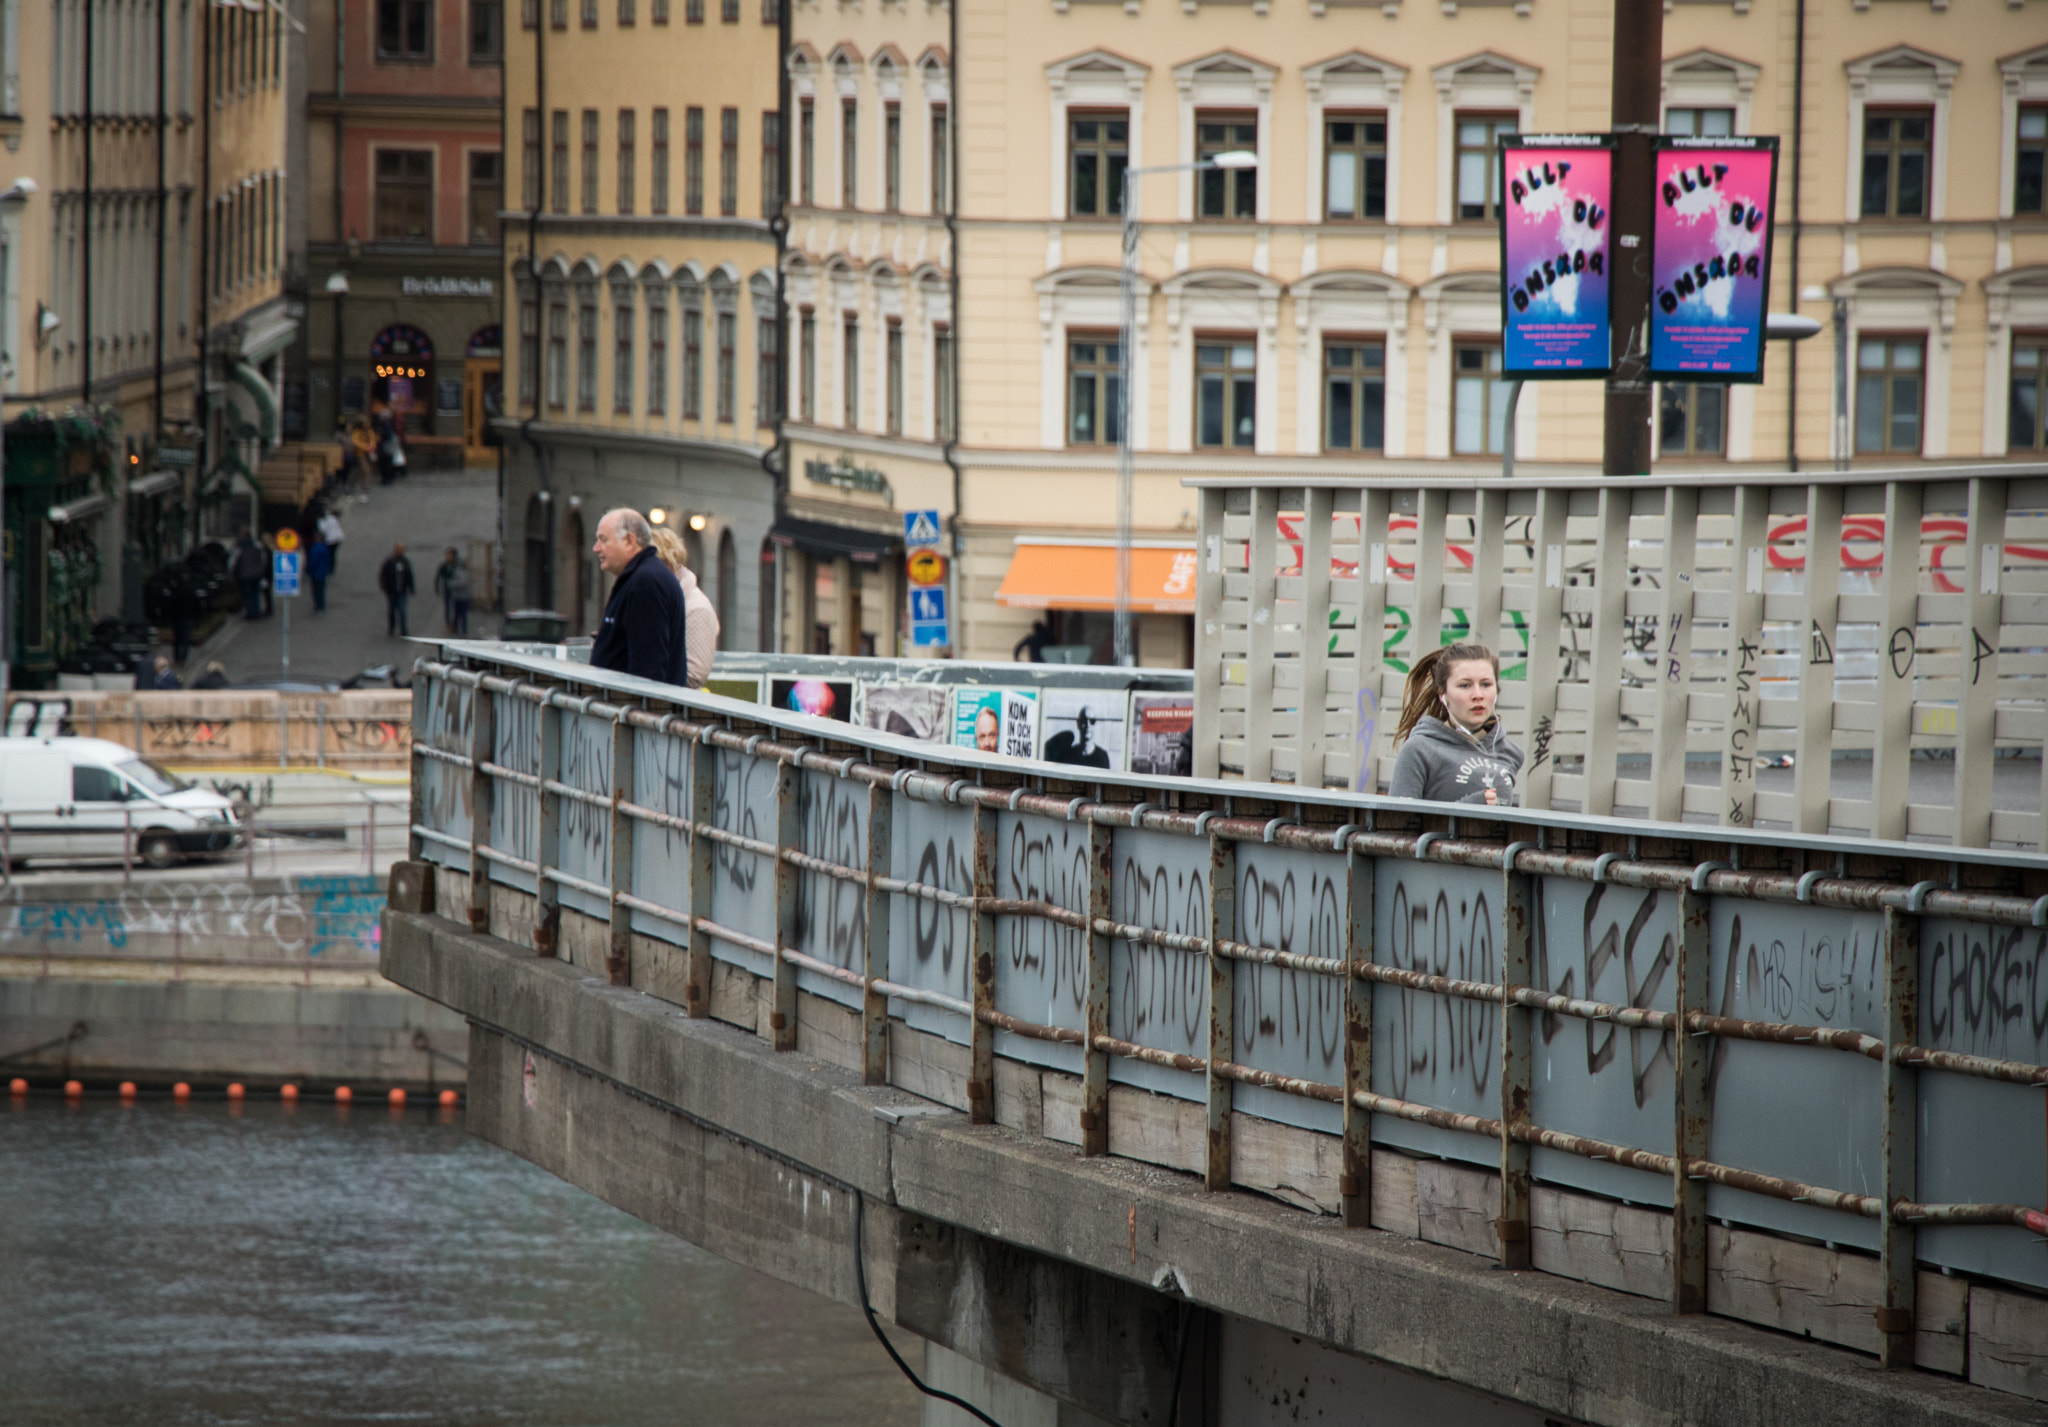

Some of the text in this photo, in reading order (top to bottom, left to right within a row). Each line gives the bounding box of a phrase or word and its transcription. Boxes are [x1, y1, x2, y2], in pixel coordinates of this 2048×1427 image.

[1511, 161, 1571, 205] ALLT
[1662, 163, 1728, 207] ALLT
[1573, 199, 1605, 231] DU
[1730, 201, 1763, 233] DU
[1008, 700, 1028, 721] KOM
[1007, 721, 1031, 739] IN OCH
